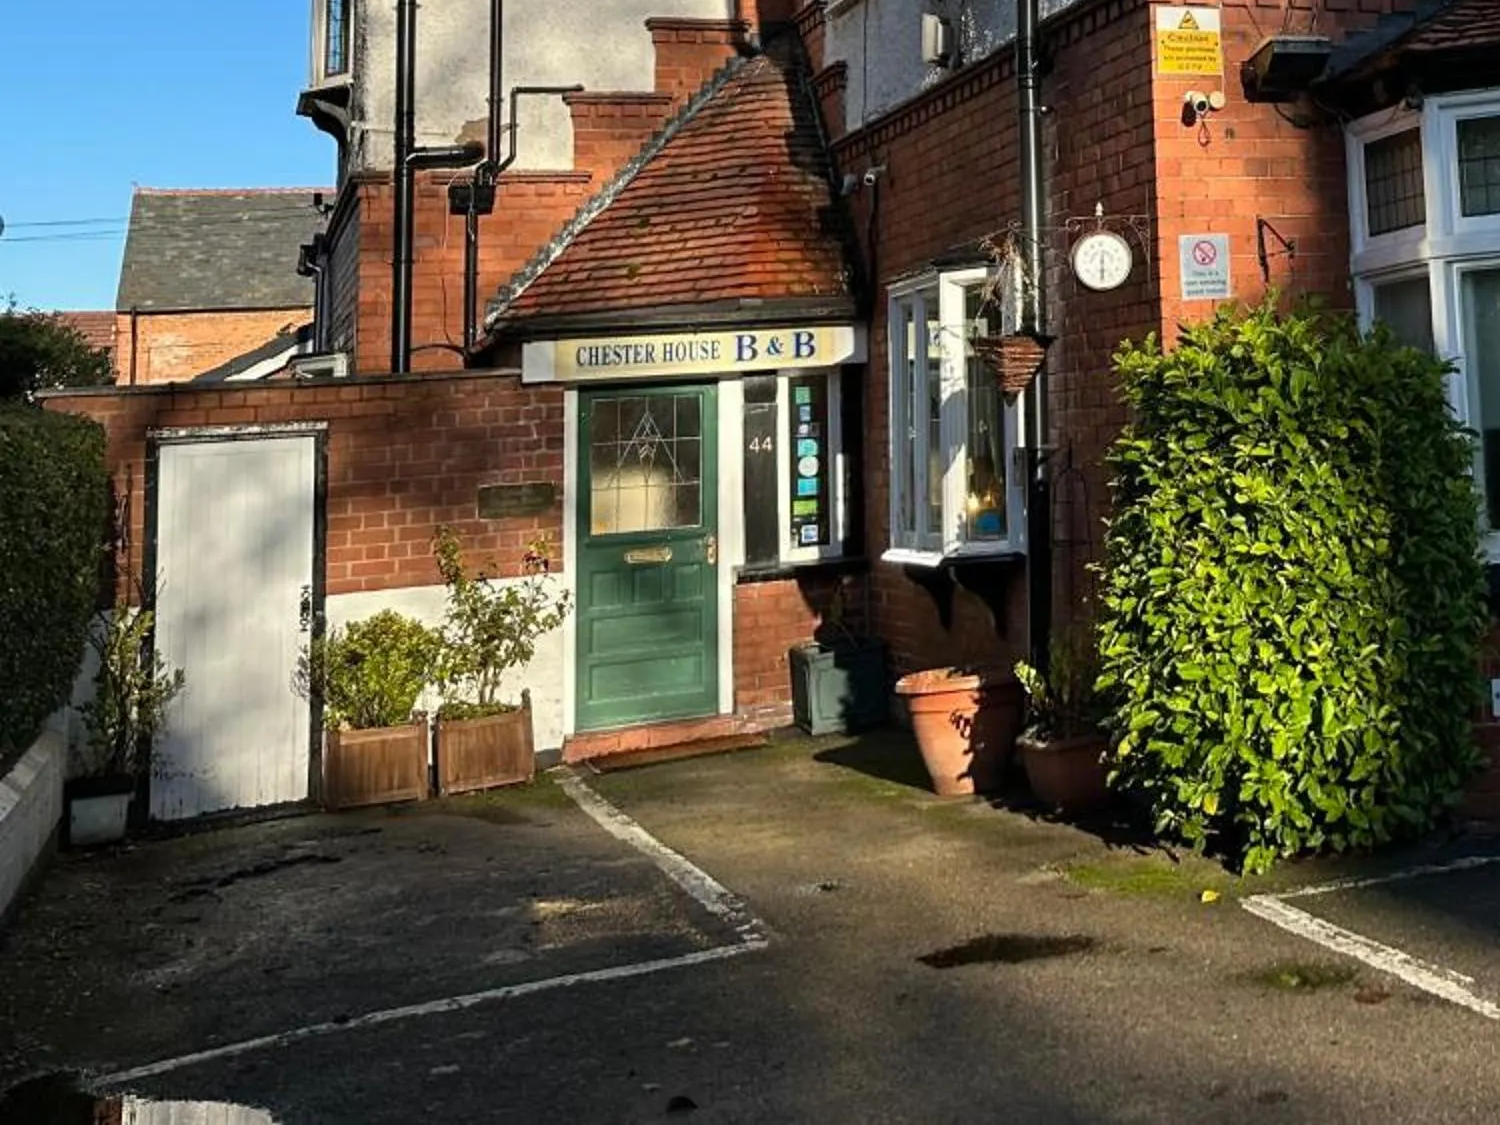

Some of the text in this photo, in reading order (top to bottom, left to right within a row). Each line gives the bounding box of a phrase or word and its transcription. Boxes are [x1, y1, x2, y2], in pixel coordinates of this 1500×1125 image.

[576, 331, 816, 367] CHESTER HOUSE B & B
[749, 436, 772, 453] 44
